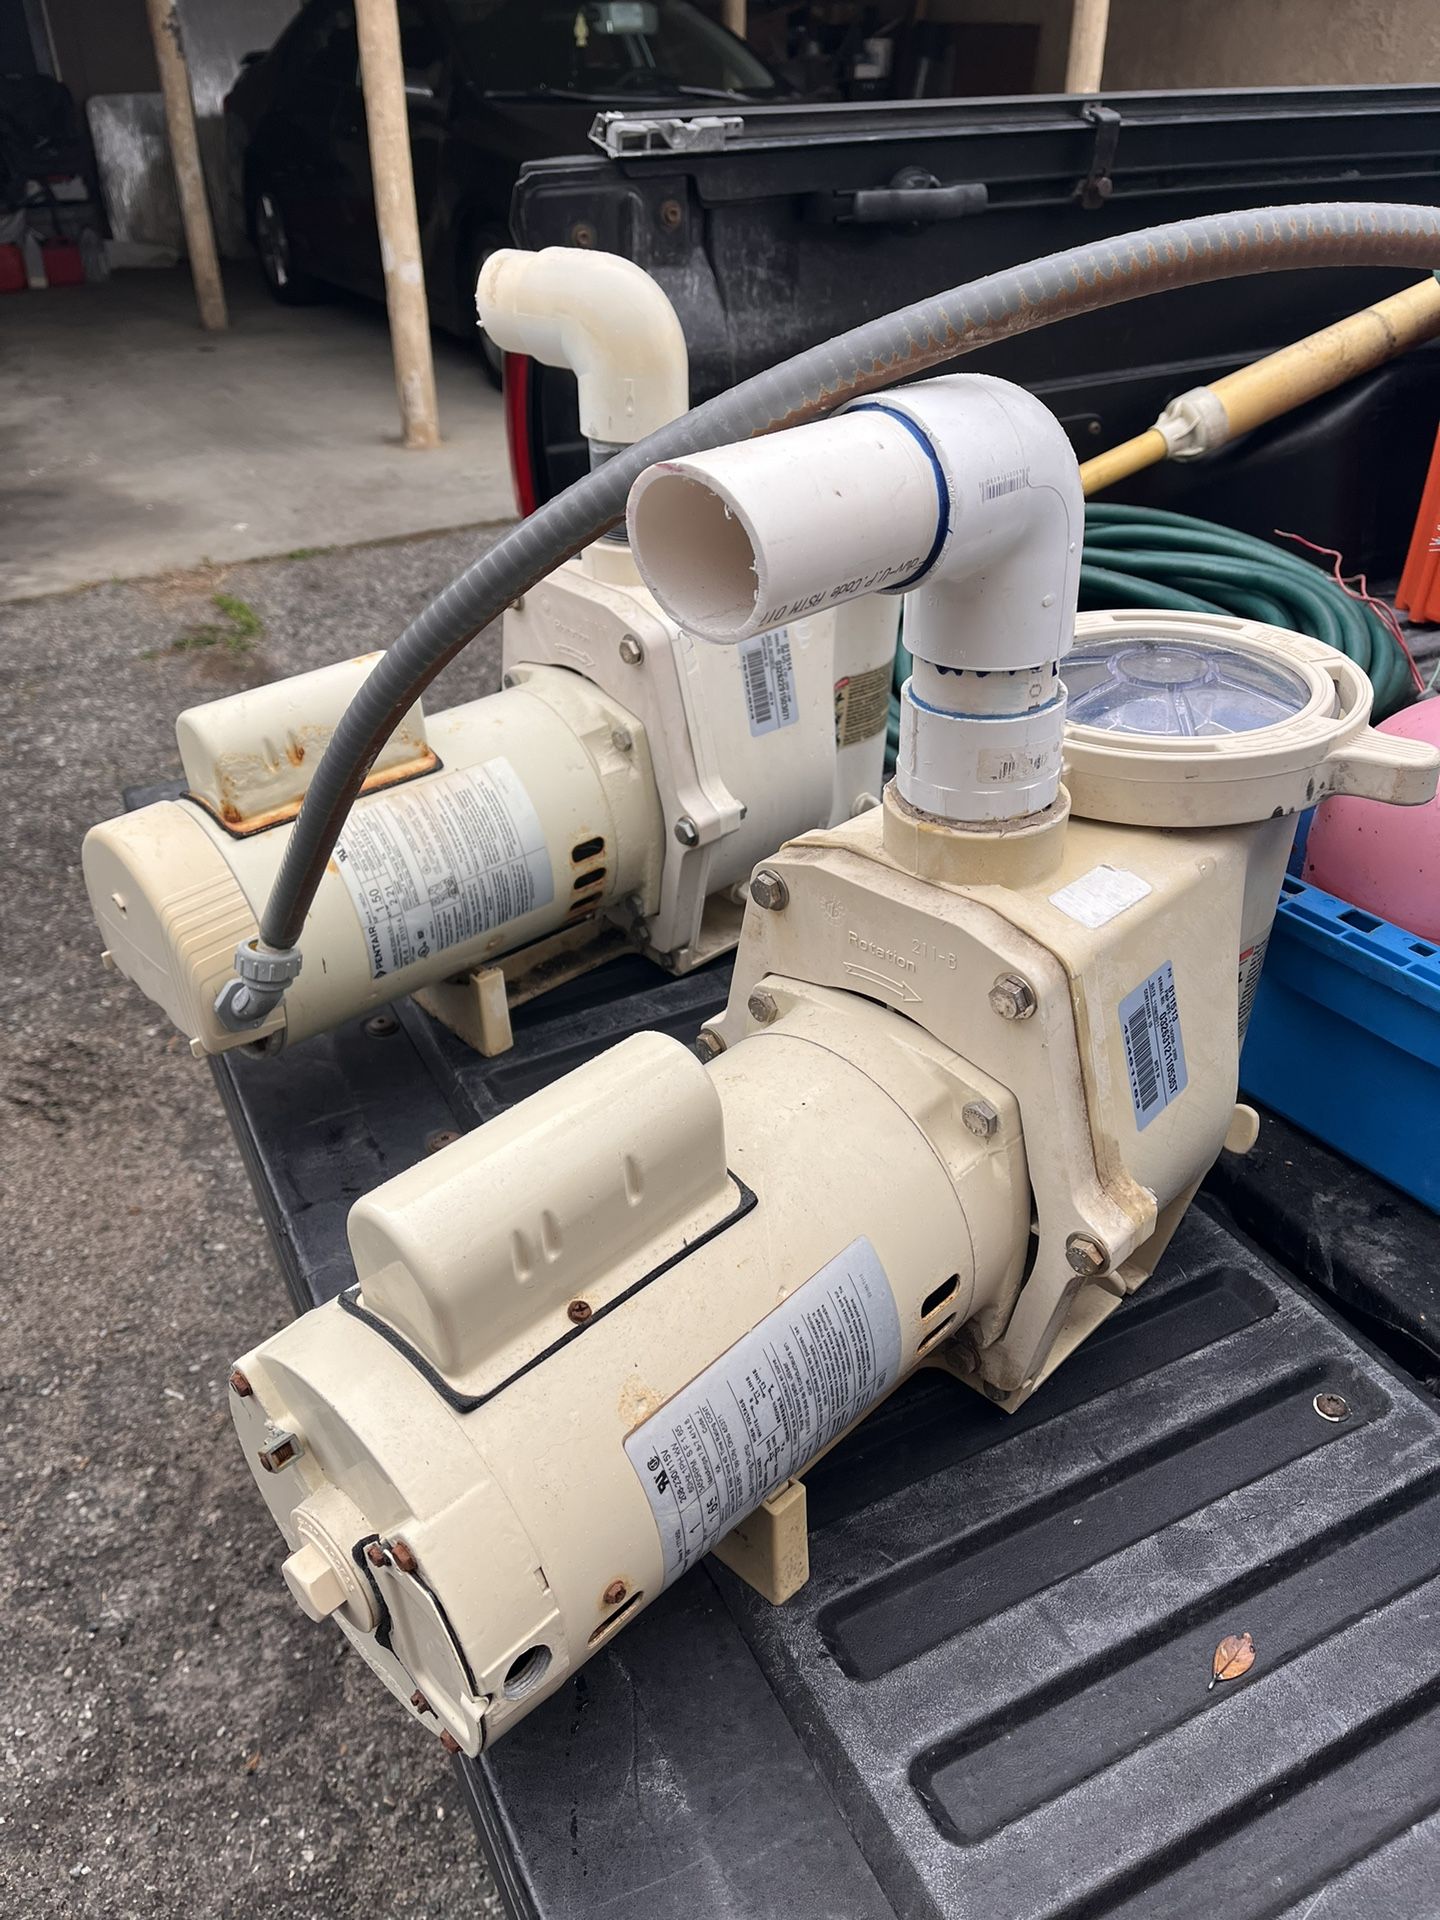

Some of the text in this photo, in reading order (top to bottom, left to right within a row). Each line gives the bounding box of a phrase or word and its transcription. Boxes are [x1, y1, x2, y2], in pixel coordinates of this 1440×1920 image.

[367, 887, 385, 912] 1.50
[367, 925, 383, 970] PENTAIR
[849, 930, 917, 973] Rotation
[912, 938, 957, 970] 211-B
[1167, 984, 1178, 1022] 011513
[701, 1404, 713, 1423] CONT
[709, 1421, 721, 1442] Rating
[660, 1446, 687, 1503] 208-230/115V
[689, 1458, 705, 1492] 3450RPM
